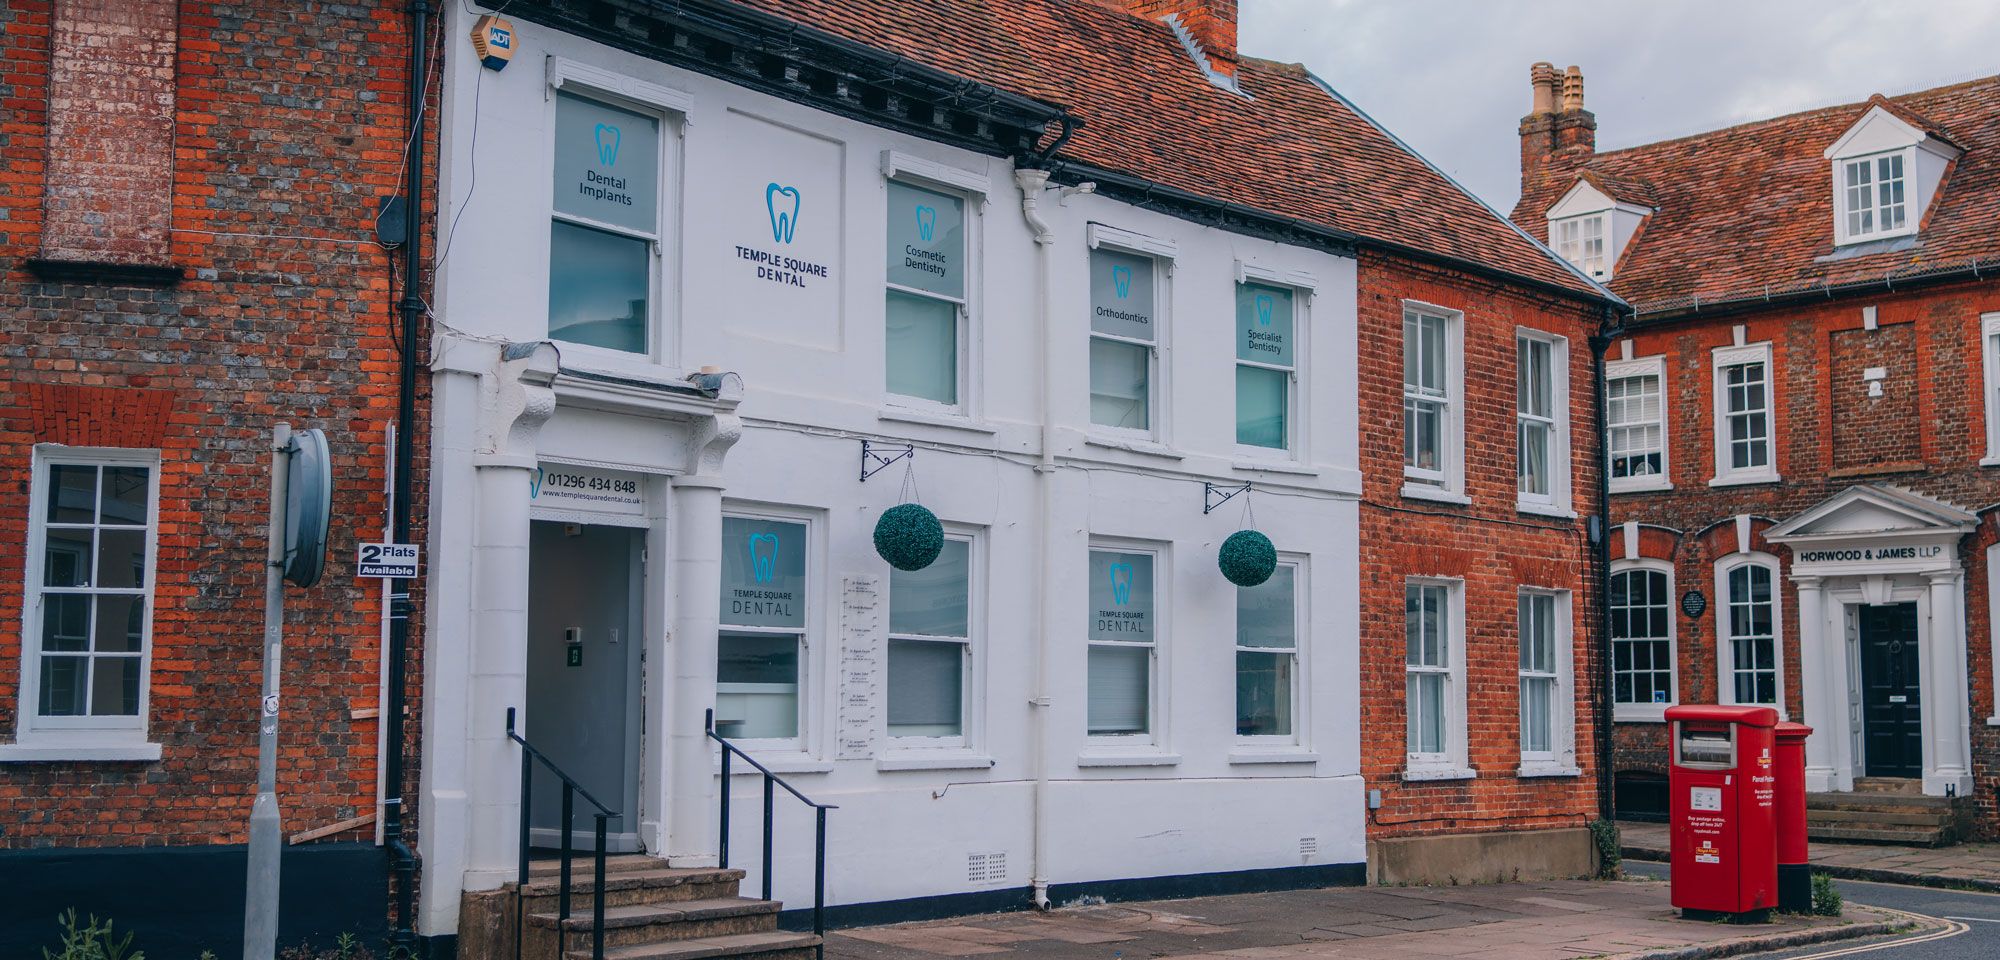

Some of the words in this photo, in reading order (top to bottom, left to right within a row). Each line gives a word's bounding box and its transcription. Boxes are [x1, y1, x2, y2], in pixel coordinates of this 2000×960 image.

[491, 28, 509, 45] ADT
[587, 170, 626, 190] Dental
[579, 182, 632, 206] Implants
[735, 246, 781, 267] TEMPLE
[783, 257, 828, 278] SQUARE
[905, 244, 946, 264] Cosmetic
[905, 257, 946, 278] Dentistry
[757, 266, 806, 288] DENTAL
[1096, 306, 1148, 325] Orthodontics
[1247, 329, 1283, 344] Specialist
[1248, 340, 1282, 356] Dentistry
[548, 473, 586, 489] 01296
[588, 477, 611, 492] 434
[614, 480, 636, 494] 848
[542, 489, 641, 505] www.templesquaredental.co.uk
[361, 545, 381, 563] 2
[382, 546, 416, 557] Flats
[1800, 550, 1862, 562] HORWOOD
[1864, 549, 1873, 560] &
[1876, 547, 1916, 559] JAMES
[1919, 546, 1942, 558] LLP
[361, 566, 414, 575] Available
[733, 589, 762, 599] TEMPLE
[764, 591, 792, 600] SQUARE
[732, 600, 792, 617] DENTAL
[1099, 610, 1121, 618] TEMPLE
[1122, 611, 1144, 619] SQUARE
[1098, 619, 1144, 633] DENTAL
